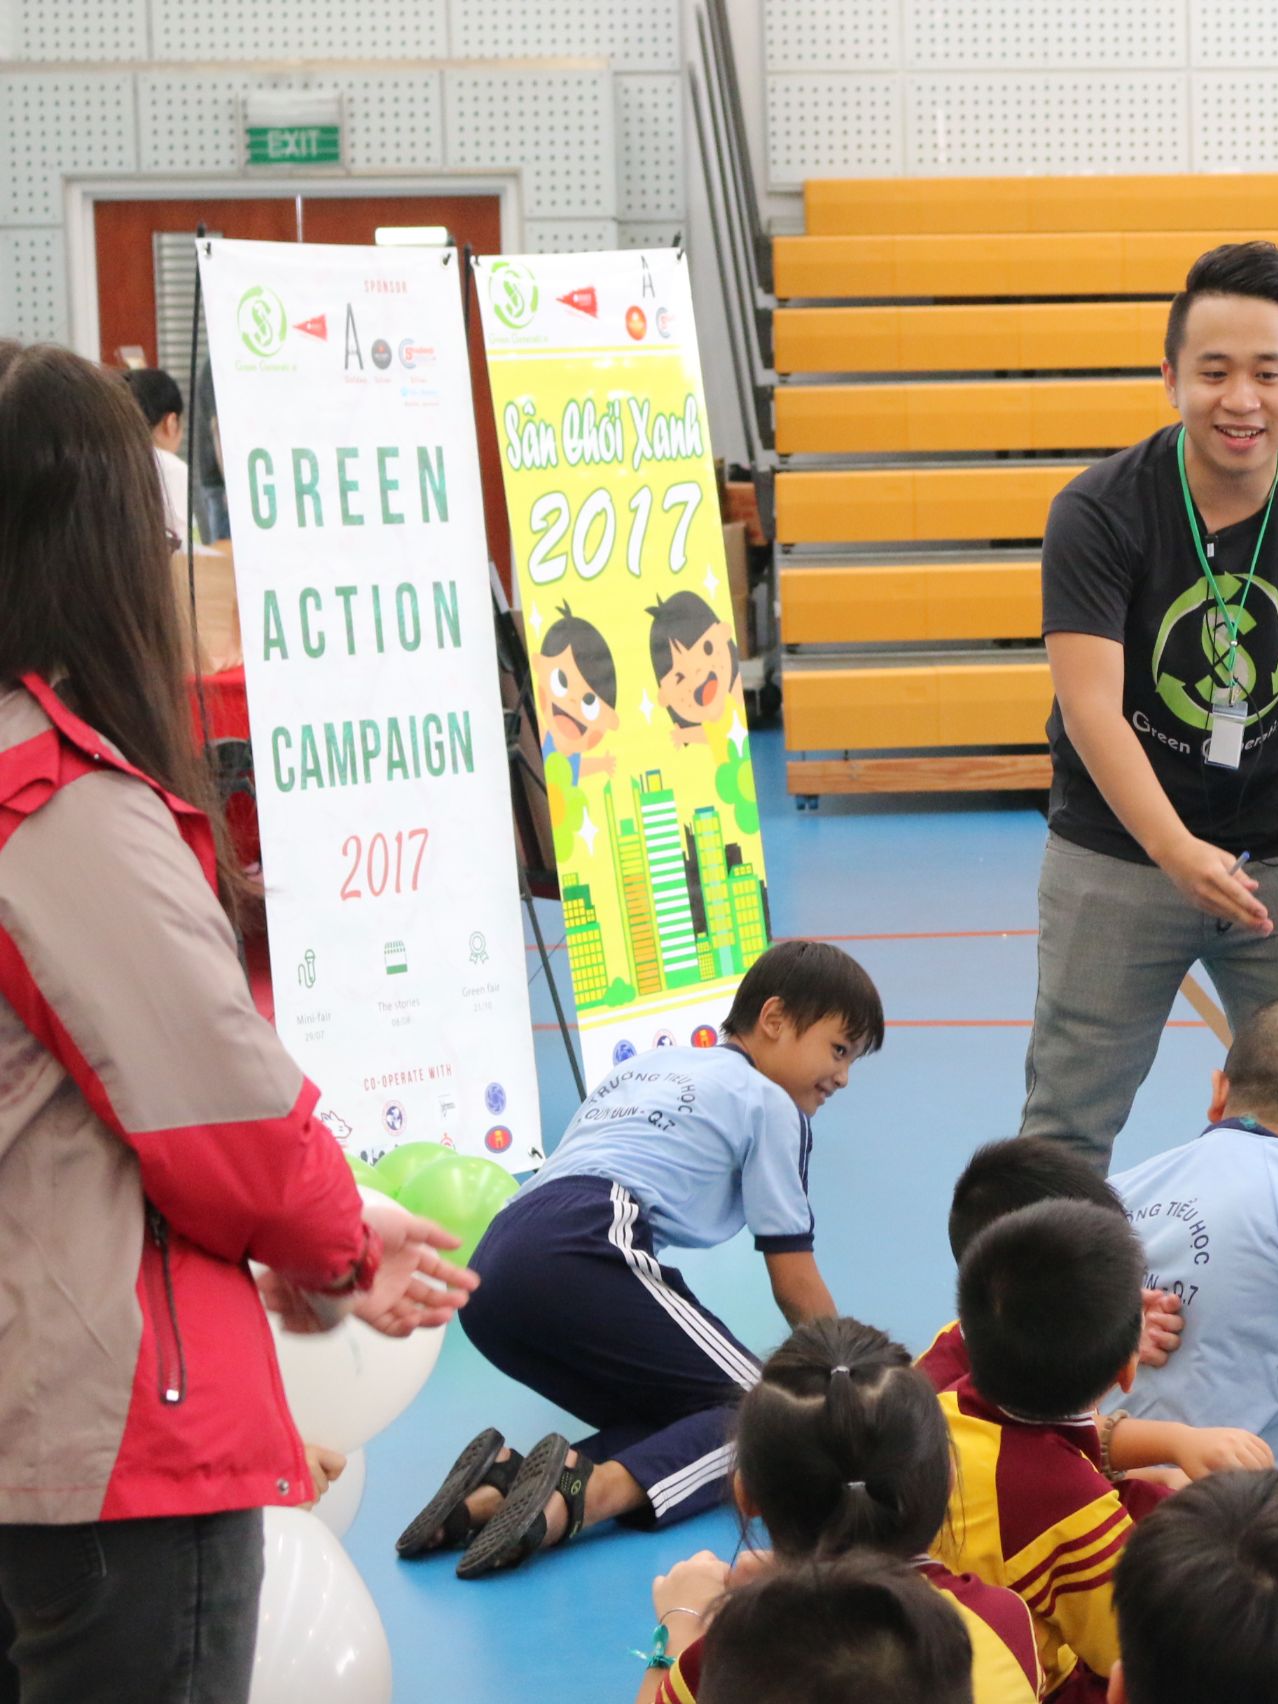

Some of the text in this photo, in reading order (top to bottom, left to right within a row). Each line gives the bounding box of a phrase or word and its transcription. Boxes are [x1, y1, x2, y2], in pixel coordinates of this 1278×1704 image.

[267, 128, 321, 158] EXIT
[364, 279, 407, 294] SPONSOR
[504, 399, 558, 472] Sân
[627, 393, 704, 472] Xanh
[248, 445, 450, 529] GREEN
[528, 481, 703, 586] 2017
[263, 580, 462, 661] ACTION
[271, 710, 475, 792] CAMPAIGN
[1132, 710, 1191, 755] Green
[340, 828, 429, 901] 2017
[378, 1000, 393, 1013] The
[462, 982, 500, 998] Green fair
[363, 1063, 452, 1092] CO-OPERATE WITH
[1189, 1220, 1210, 1265] HỌC
